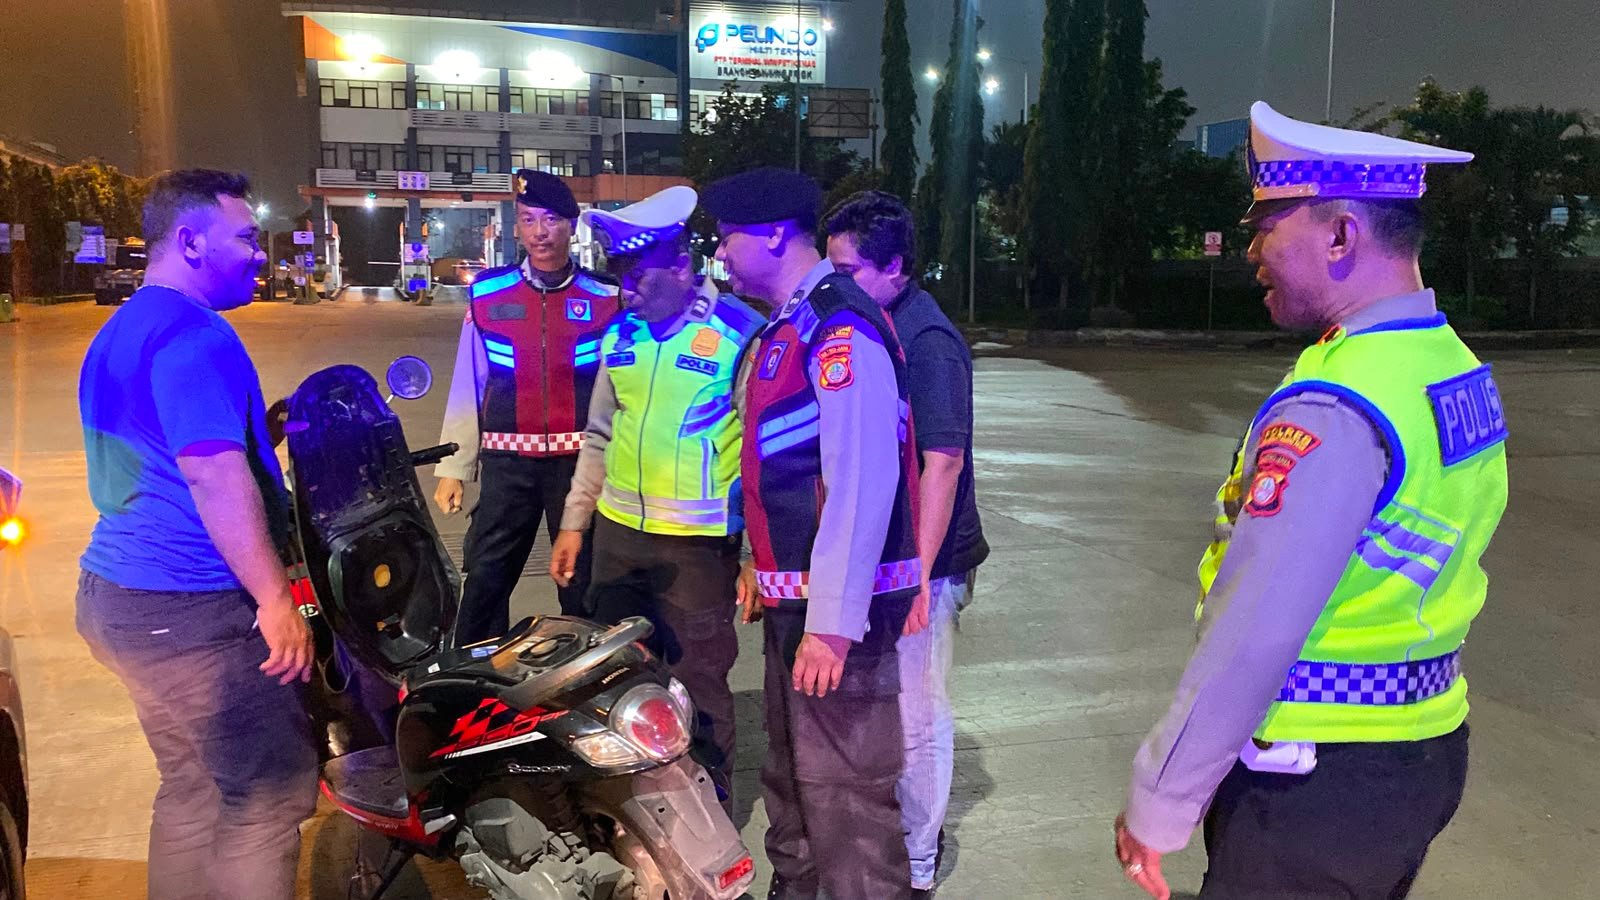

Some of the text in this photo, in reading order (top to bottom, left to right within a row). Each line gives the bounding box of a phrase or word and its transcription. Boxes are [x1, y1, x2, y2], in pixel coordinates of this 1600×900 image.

[726, 23, 818, 46] PELINDO
[679, 357, 715, 372] POLRI
[600, 667, 631, 684] HONDA
